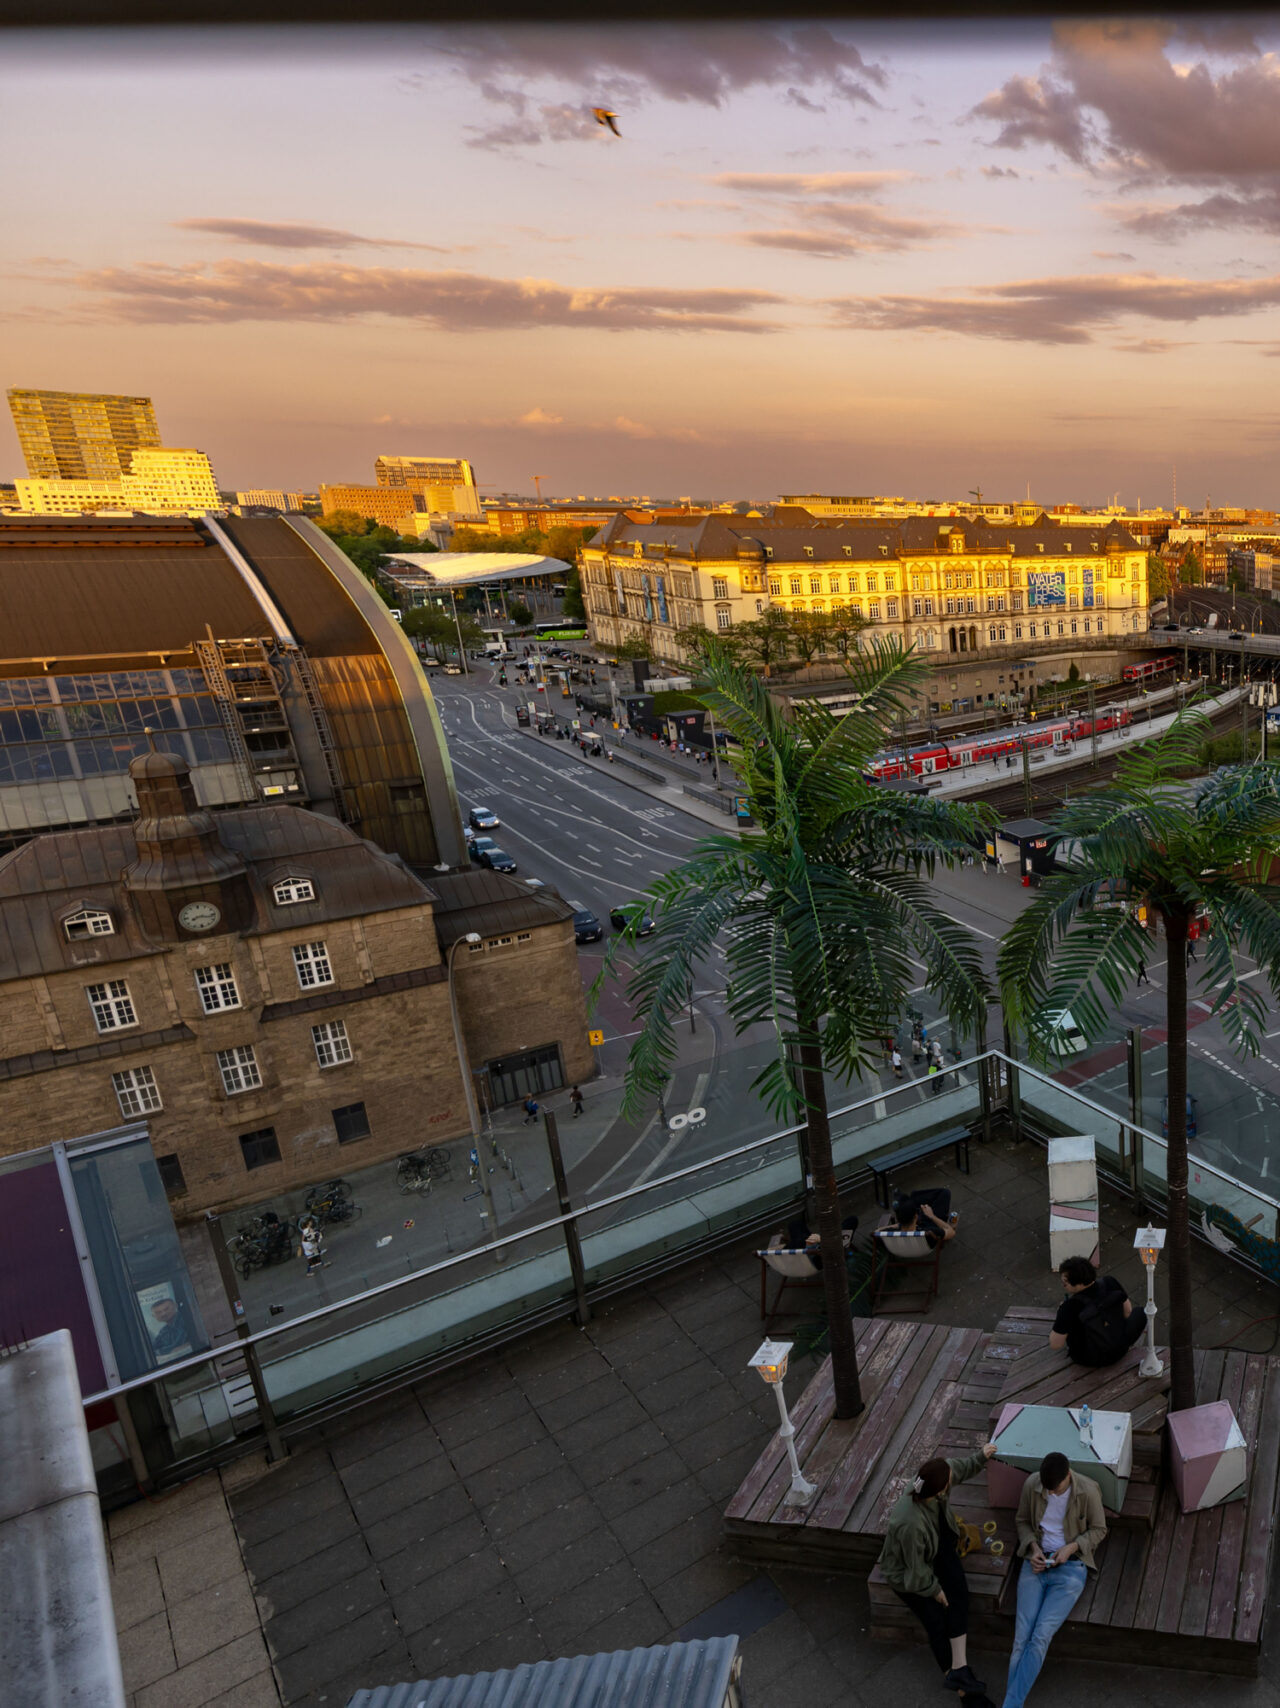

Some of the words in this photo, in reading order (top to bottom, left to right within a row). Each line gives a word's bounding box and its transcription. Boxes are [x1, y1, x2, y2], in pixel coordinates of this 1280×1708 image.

[1030, 573, 1062, 585] WATER
[1036, 583, 1066, 597] PRESS
[1029, 593, 1049, 605] URE
[558, 766, 593, 777] BUS
[635, 807, 675, 820] BUS
